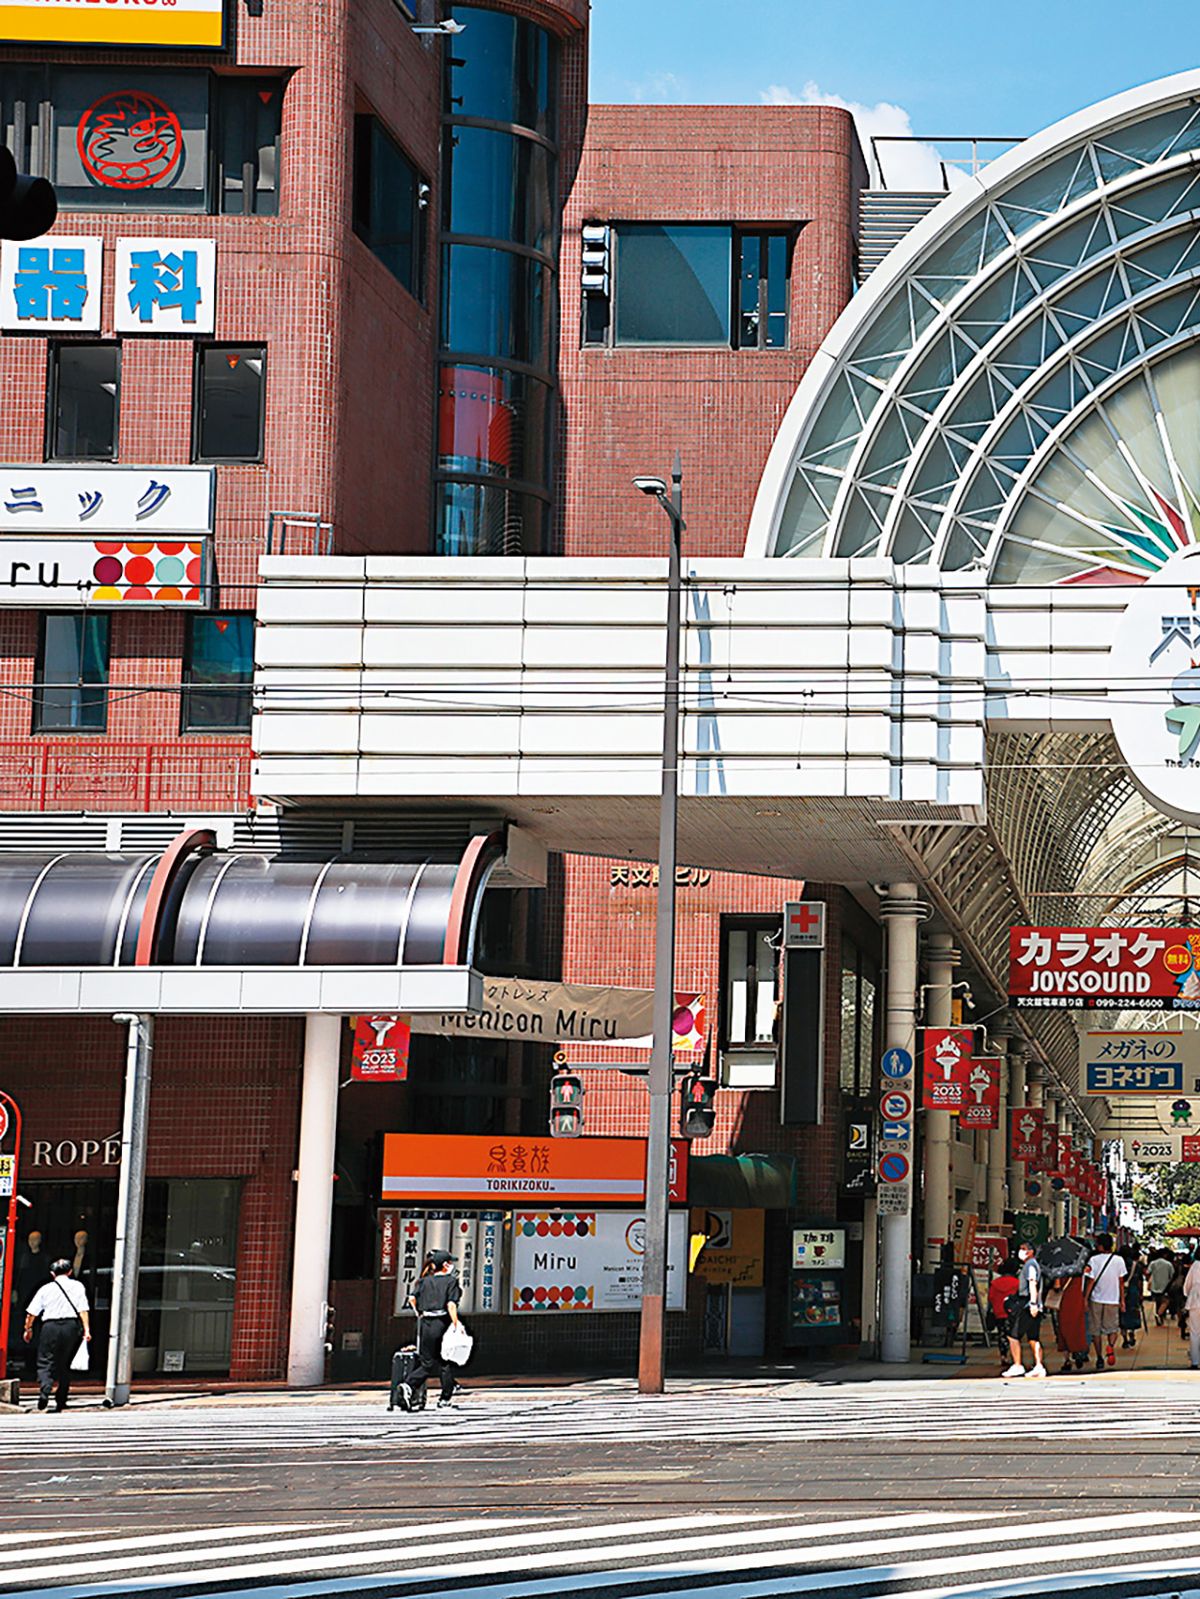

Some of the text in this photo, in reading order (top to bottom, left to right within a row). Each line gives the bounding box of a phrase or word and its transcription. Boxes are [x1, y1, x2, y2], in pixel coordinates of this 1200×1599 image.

[6, 480, 171, 520] ニック
[10, 559, 59, 586] ru
[1165, 759, 1183, 768] The
[1017, 932, 1165, 968] カラオケ
[1030, 971, 1150, 992] JOYSOUND
[557, 1010, 617, 1038] Miru
[362, 1053, 397, 1065] 2023
[1097, 1039, 1176, 1059] メガネの
[1095, 1066, 1176, 1089] ヨネザワ
[933, 1086, 963, 1096] 2023
[967, 1108, 992, 1117] 2023
[32, 1131, 121, 1166] ROPÉ
[1142, 1146, 1172, 1156] 2023
[487, 1179, 551, 1191] TORIKIZOKU
[534, 1253, 576, 1270] Miru
